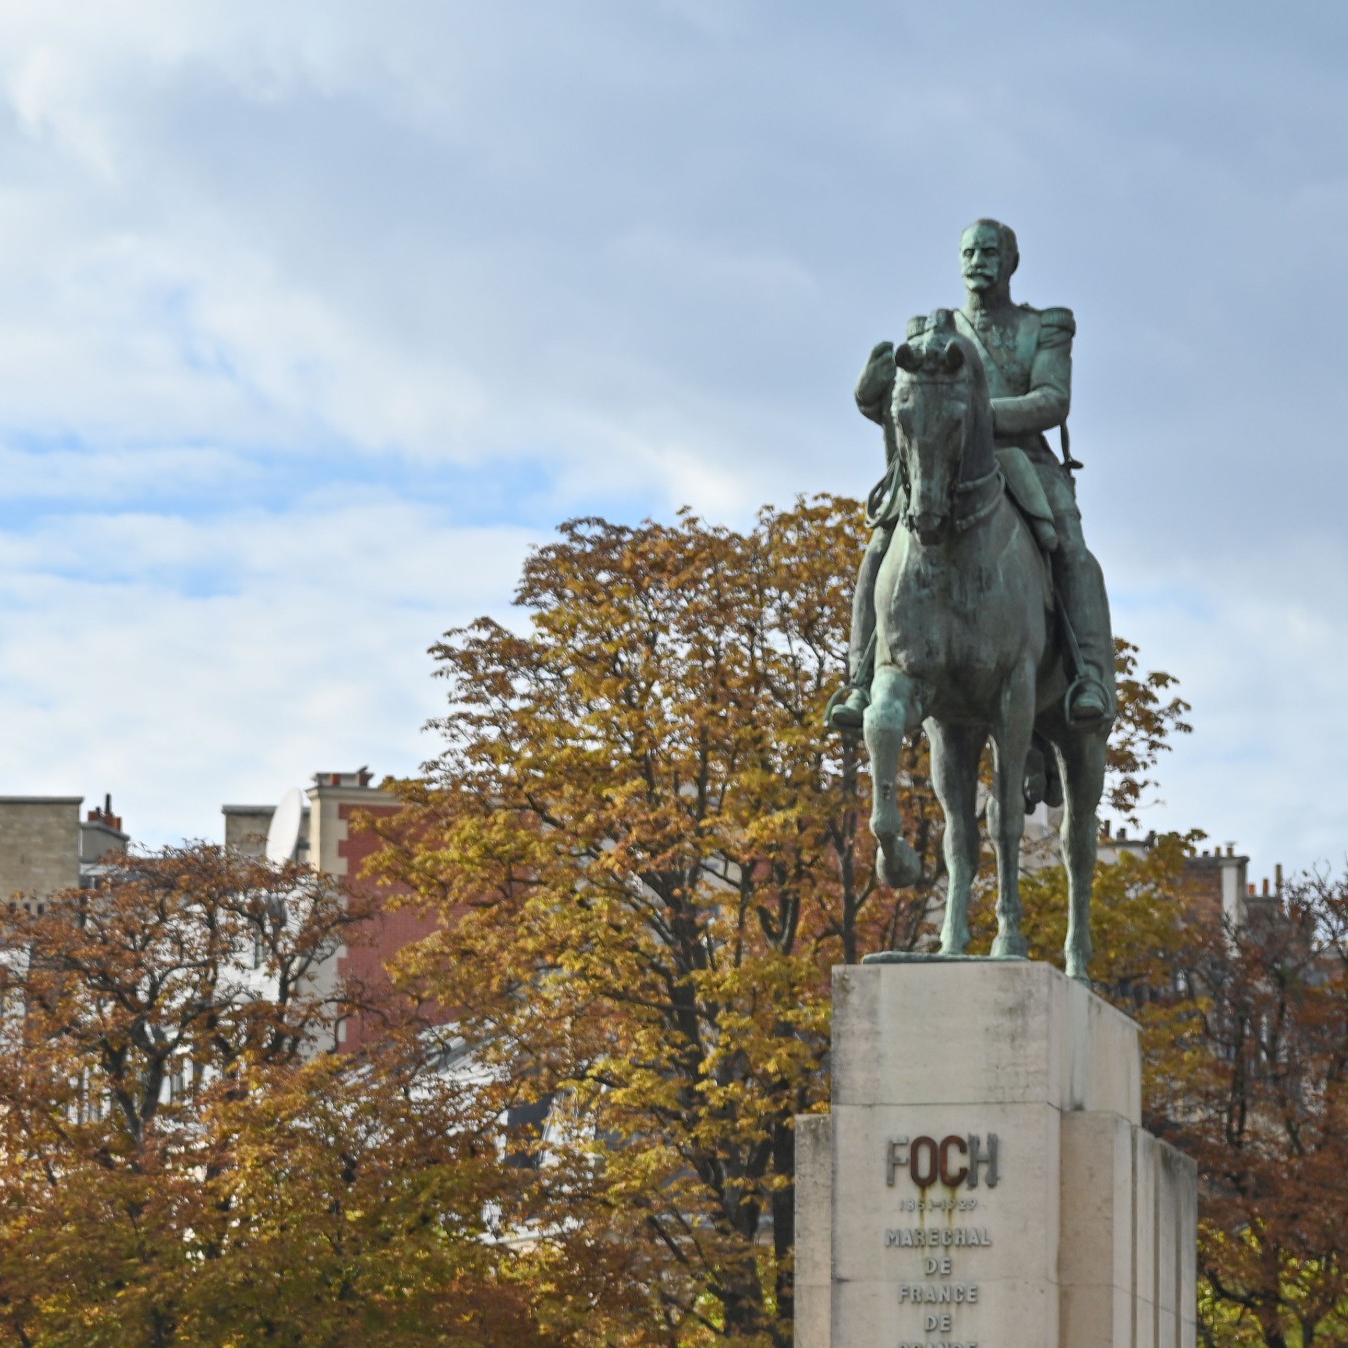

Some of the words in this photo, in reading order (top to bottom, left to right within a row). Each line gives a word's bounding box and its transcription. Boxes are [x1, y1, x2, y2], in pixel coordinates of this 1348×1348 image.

[887, 1133, 999, 1189] FOCH
[925, 1256, 951, 1276] DE
[898, 1285, 978, 1304] FRANCE
[925, 1313, 951, 1332] DE
